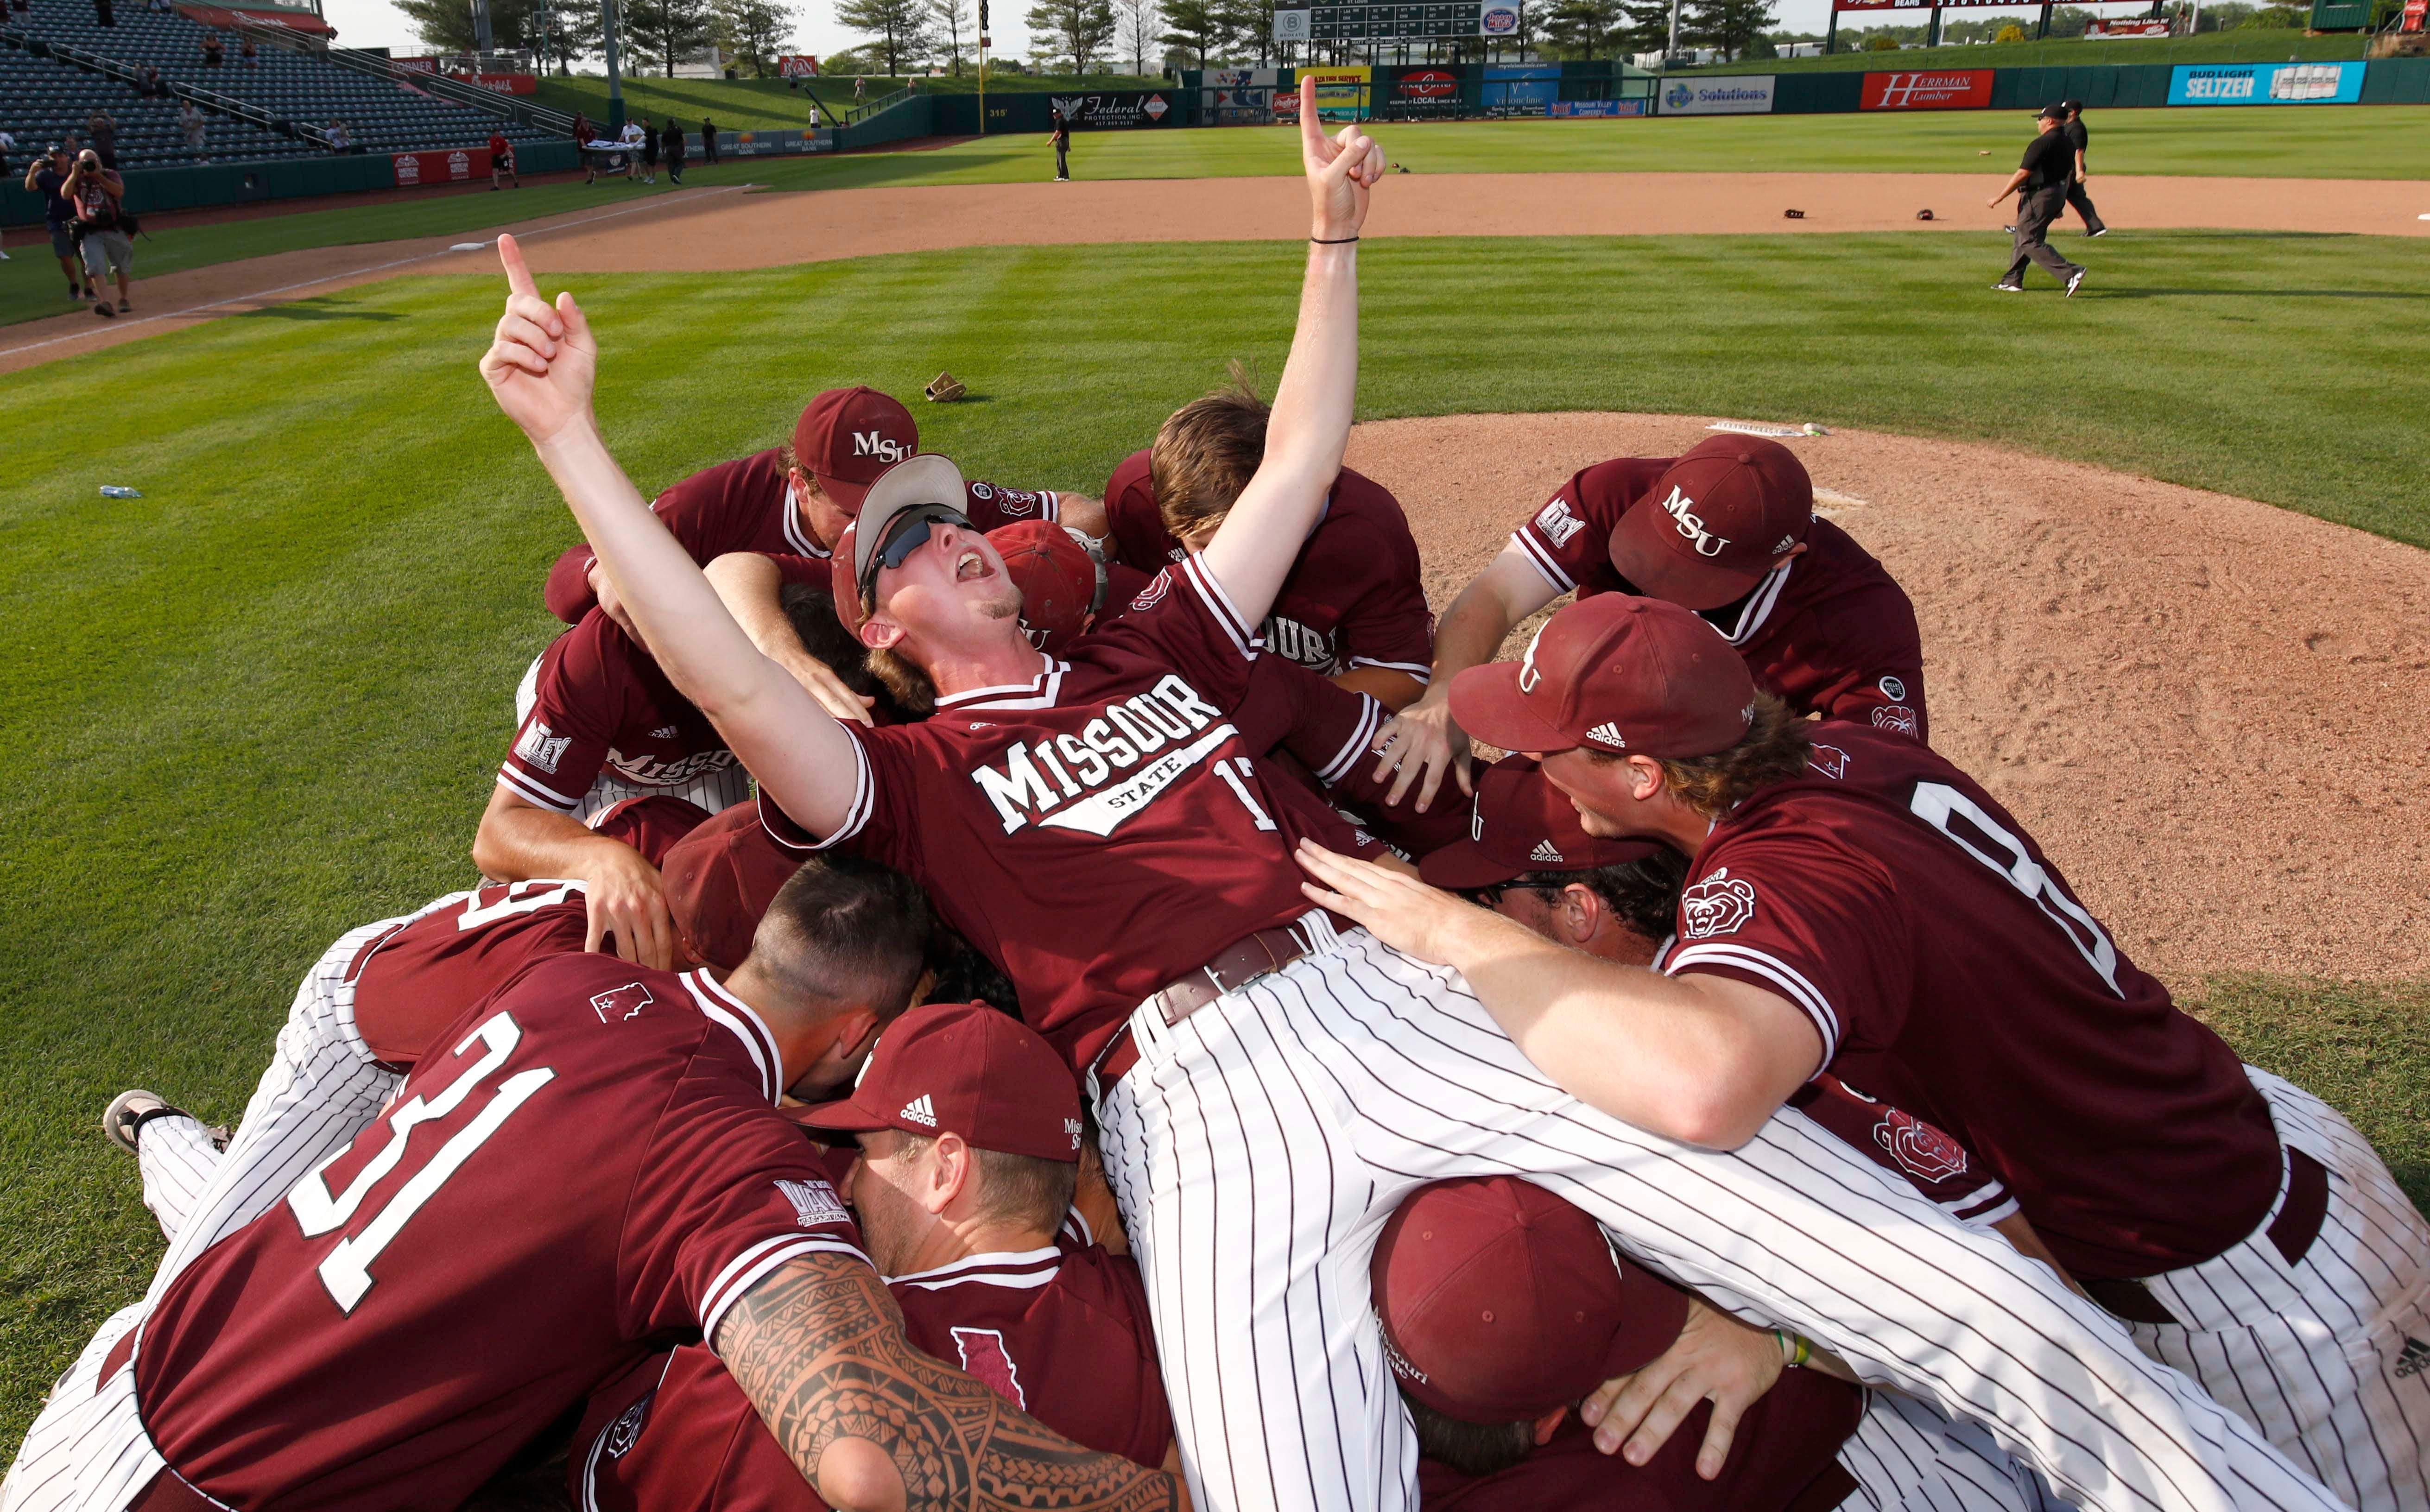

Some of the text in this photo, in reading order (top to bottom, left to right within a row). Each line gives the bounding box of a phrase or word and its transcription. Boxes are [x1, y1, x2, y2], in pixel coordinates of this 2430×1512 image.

[1487, 13, 1513, 21] Jersey
[1699, 88, 1768, 101] Solutions
[1878, 74, 1971, 107] HERRMAN
[1913, 91, 1952, 101] Lumber
[2185, 77, 2255, 98] SELTZER
[1085, 95, 1144, 115] Federal
[852, 430, 912, 463] MSU
[1661, 484, 1731, 557] MSU
[1586, 730, 1626, 749] adidas
[1107, 757, 1182, 809] STATE
[1530, 853, 1563, 862] adidas
[900, 1108, 937, 1128] adidas
[287, 1011, 558, 1318] 31
